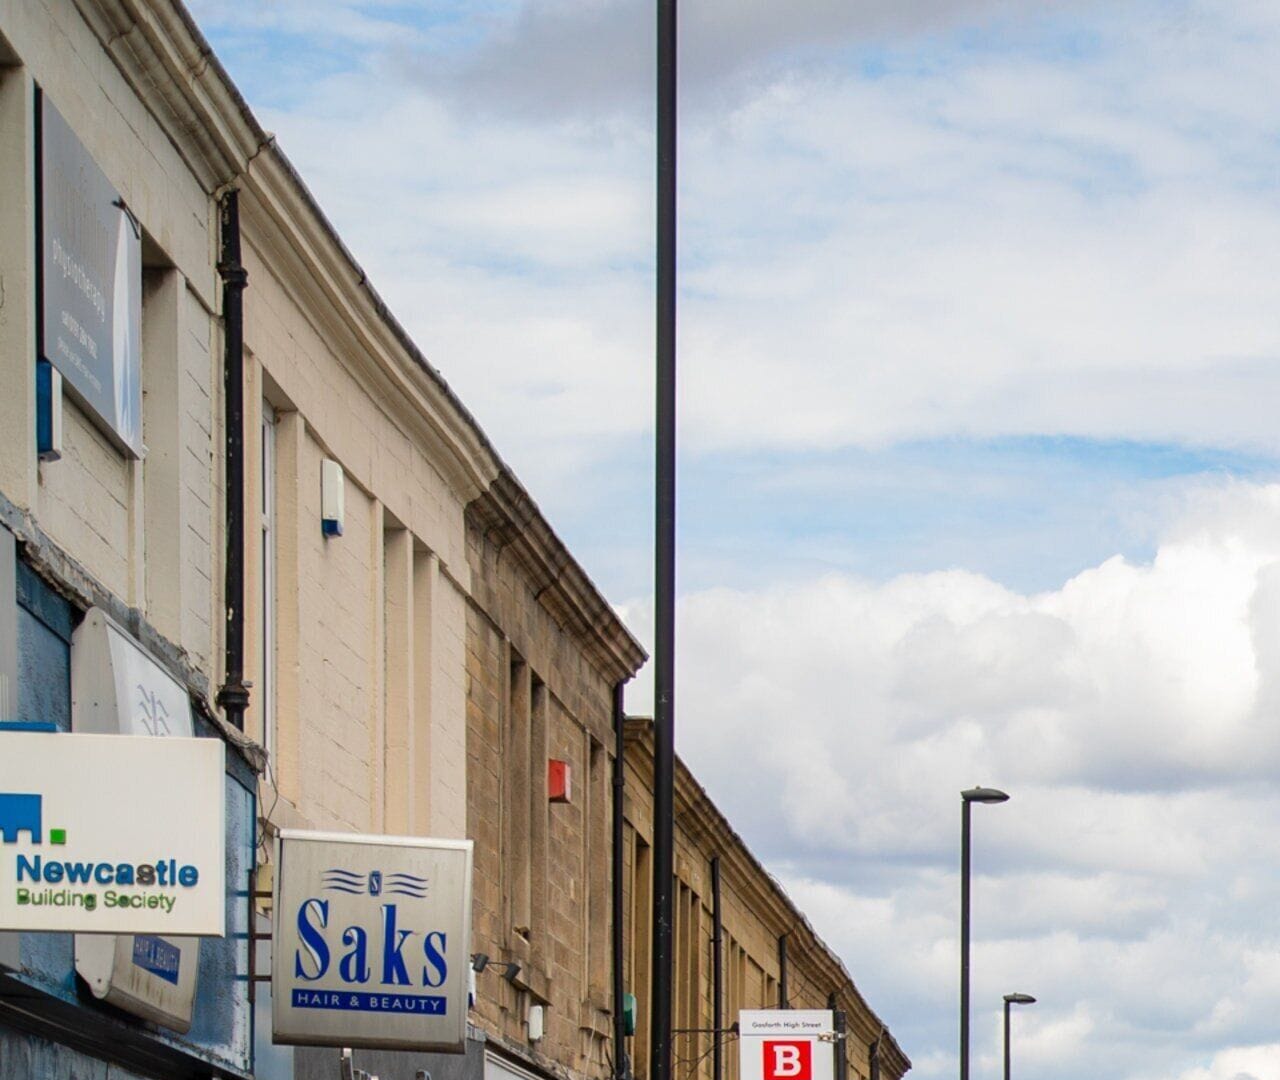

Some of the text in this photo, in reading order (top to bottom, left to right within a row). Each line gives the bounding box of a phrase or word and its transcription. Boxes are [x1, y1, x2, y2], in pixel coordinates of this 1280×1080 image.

[16, 854, 199, 887] Newcastle
[17, 888, 176, 913] Building Society
[296, 898, 448, 988] Saks
[298, 993, 440, 1011] HAIR & BEAUTY
[773, 1045, 801, 1077] B
